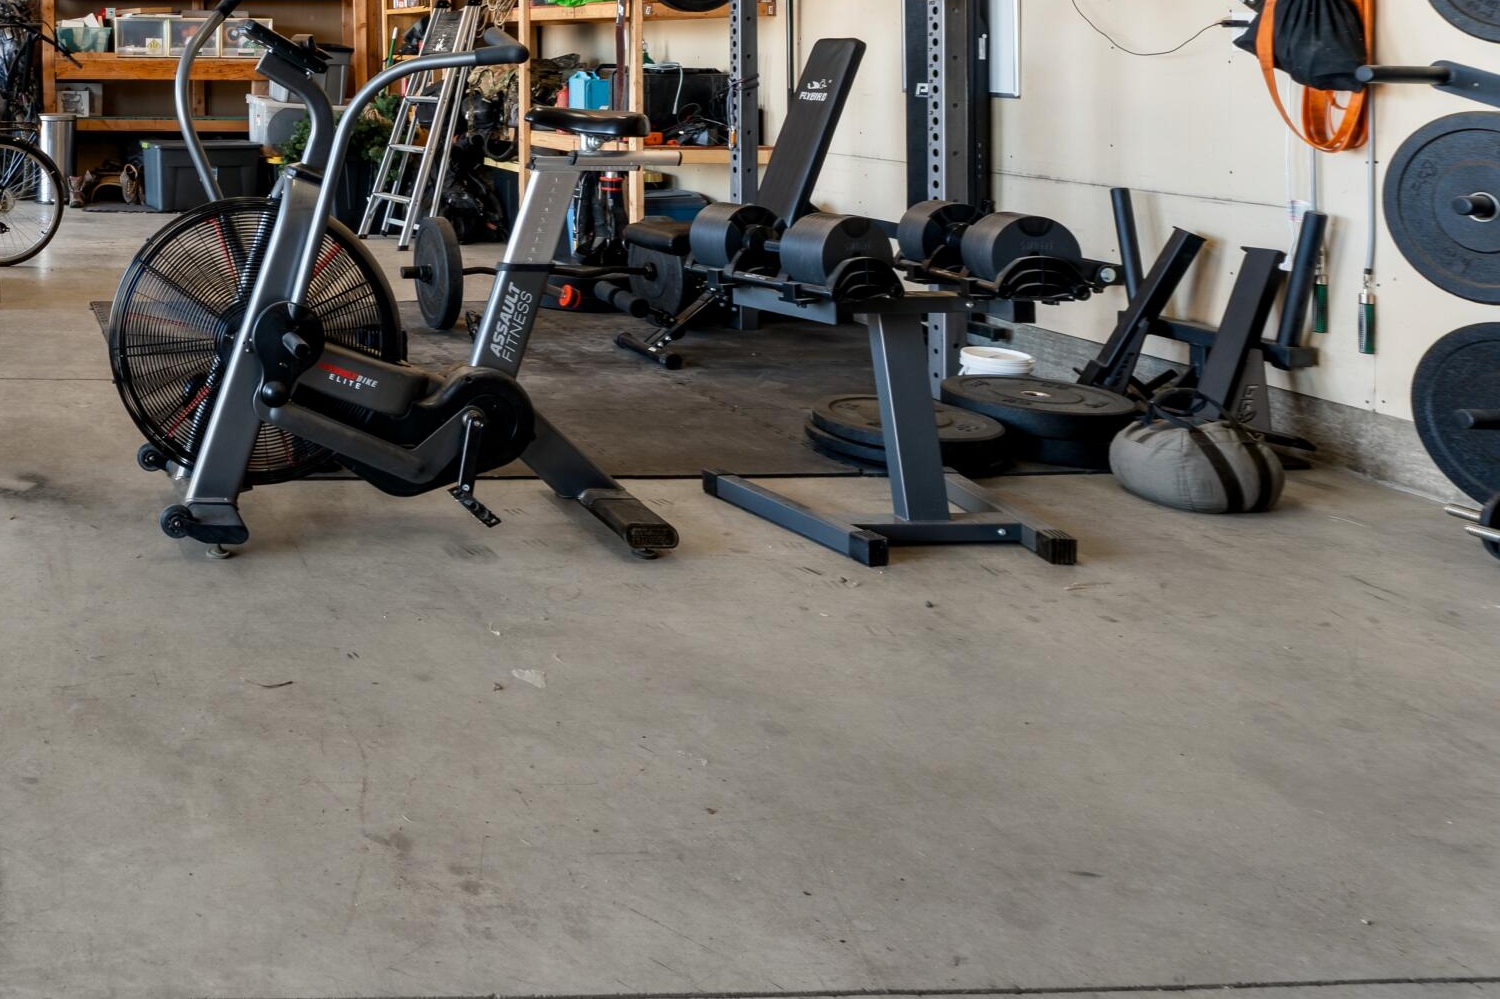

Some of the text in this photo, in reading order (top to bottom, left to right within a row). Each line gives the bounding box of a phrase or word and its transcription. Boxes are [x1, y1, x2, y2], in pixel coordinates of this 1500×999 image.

[799, 91, 828, 102] FLYBIRD
[489, 281, 521, 358] ASSAULT
[501, 290, 533, 363] FITNESS
[328, 373, 362, 390] ELITE
